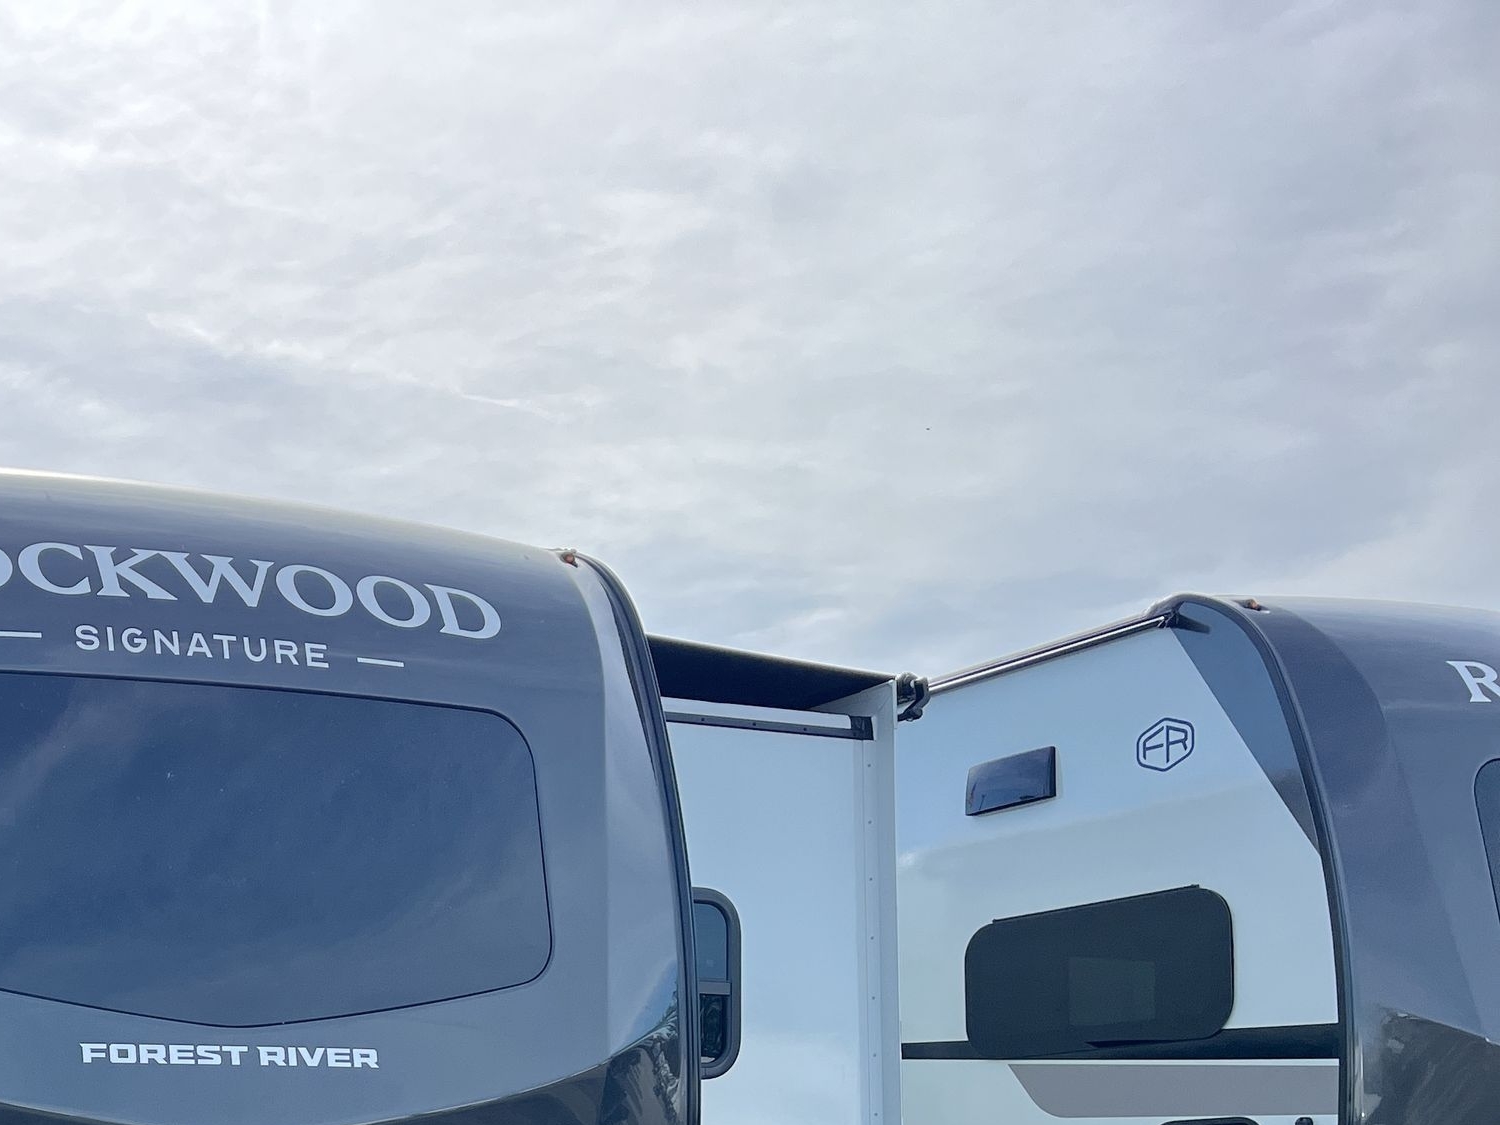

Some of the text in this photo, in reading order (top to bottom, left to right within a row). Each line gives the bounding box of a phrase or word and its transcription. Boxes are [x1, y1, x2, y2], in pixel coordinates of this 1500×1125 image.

[75, 624, 329, 669] SIGNATURE
[79, 1042, 380, 1069] FOREST RIVER
